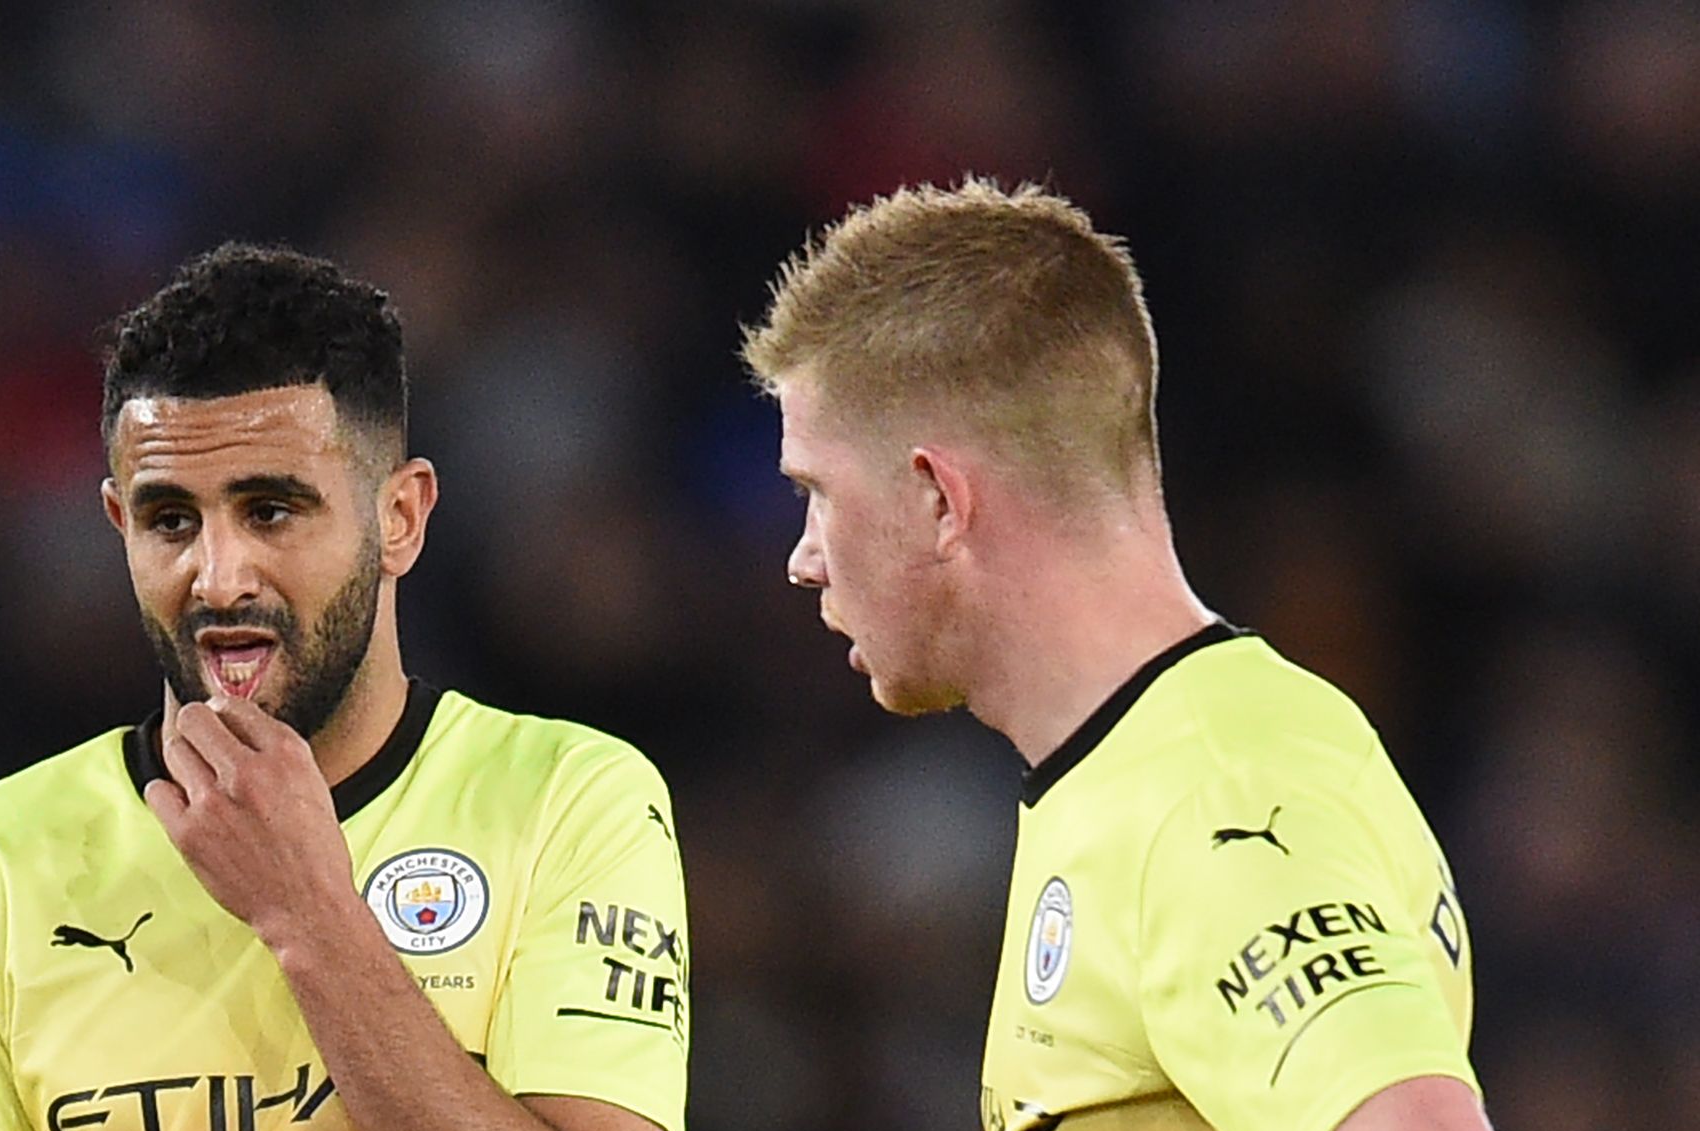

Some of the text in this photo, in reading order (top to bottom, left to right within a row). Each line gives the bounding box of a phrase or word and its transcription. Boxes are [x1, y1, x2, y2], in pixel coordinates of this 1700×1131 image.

[375, 855, 475, 893] MANCHESTER
[409, 934, 447, 949] CITY
[1215, 901, 1388, 1015] NEXEN
[418, 974, 476, 990] YEARS
[1254, 943, 1387, 1029] TIRE
